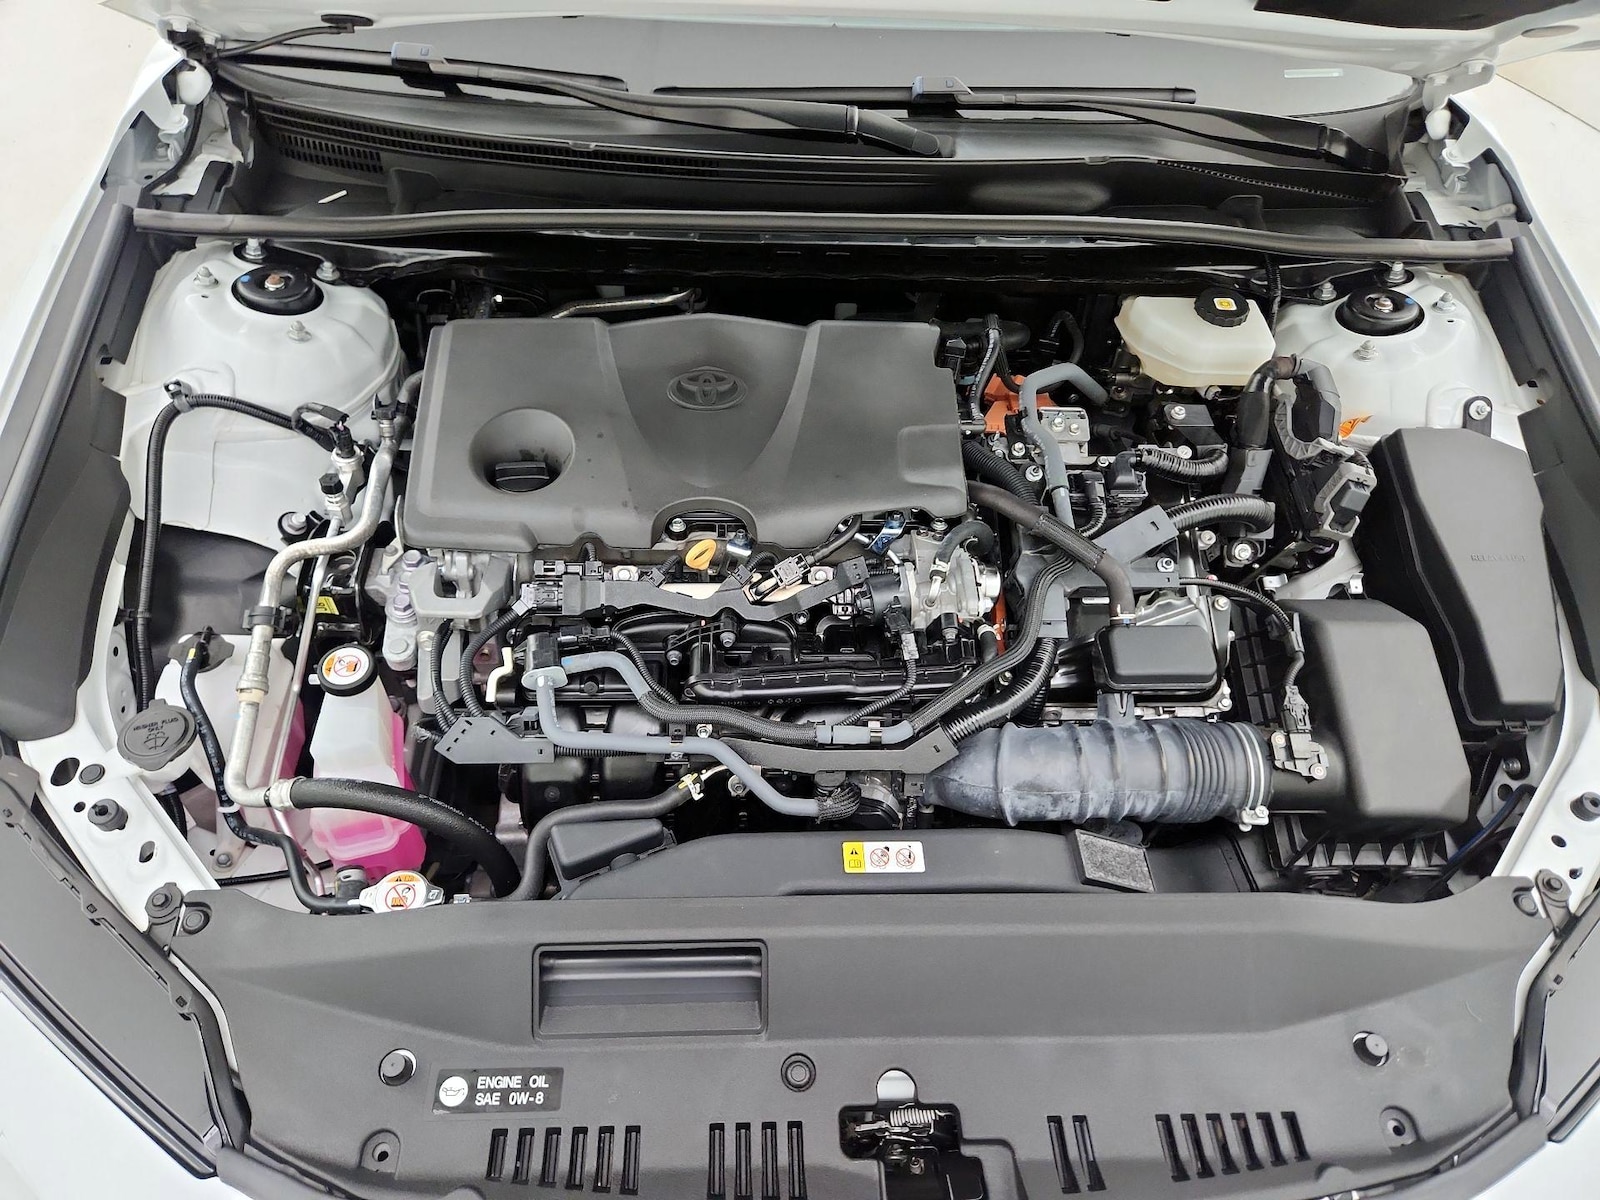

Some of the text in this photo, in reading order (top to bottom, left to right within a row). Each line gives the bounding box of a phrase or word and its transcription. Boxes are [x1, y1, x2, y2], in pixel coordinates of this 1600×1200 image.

[476, 1075, 549, 1089] ENGINE OIL
[475, 1092, 544, 1106] SAE 0W-8
